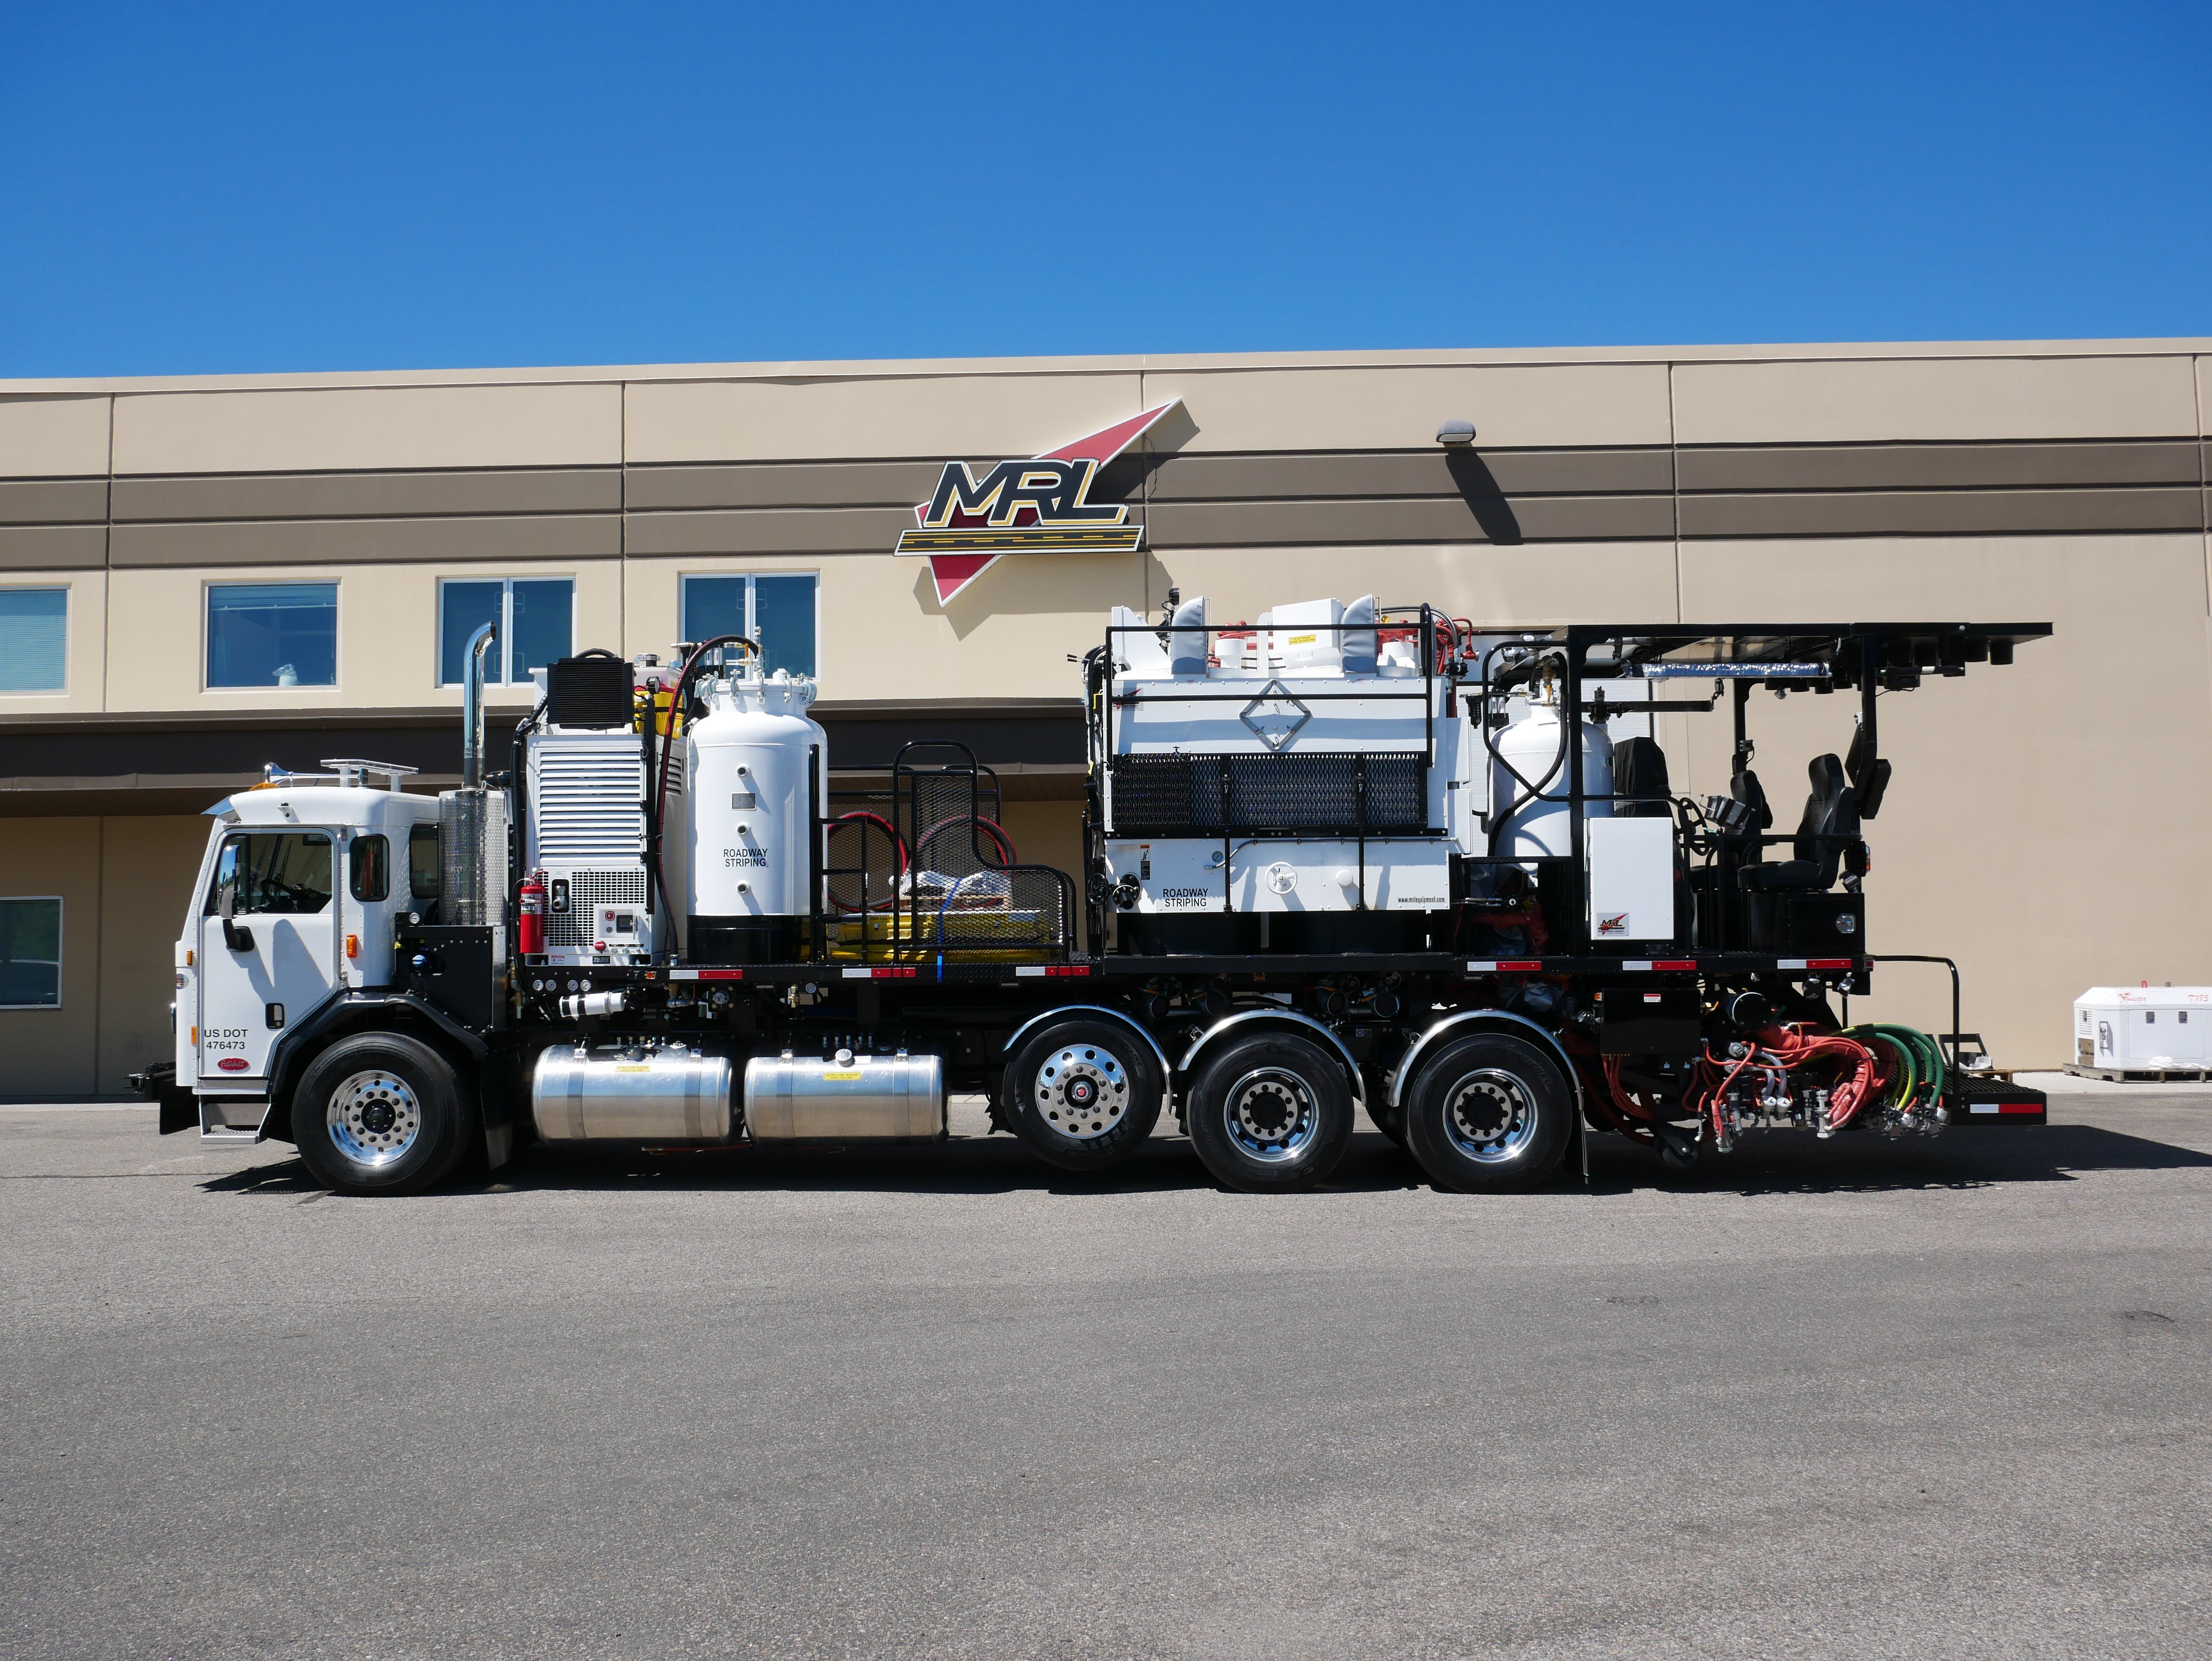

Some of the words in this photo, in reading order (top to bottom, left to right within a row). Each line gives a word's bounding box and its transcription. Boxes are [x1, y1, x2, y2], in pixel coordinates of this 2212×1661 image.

[923, 458, 1129, 527] MRL
[724, 848, 767, 857] ROADWAY
[725, 858, 766, 867] STRIPING
[1163, 888, 1208, 897] ROADWAY
[1165, 898, 1207, 907] STRIPING
[2118, 992, 2146, 1002] Twister
[204, 1029, 220, 1037] US
[224, 1029, 249, 1037] DOT
